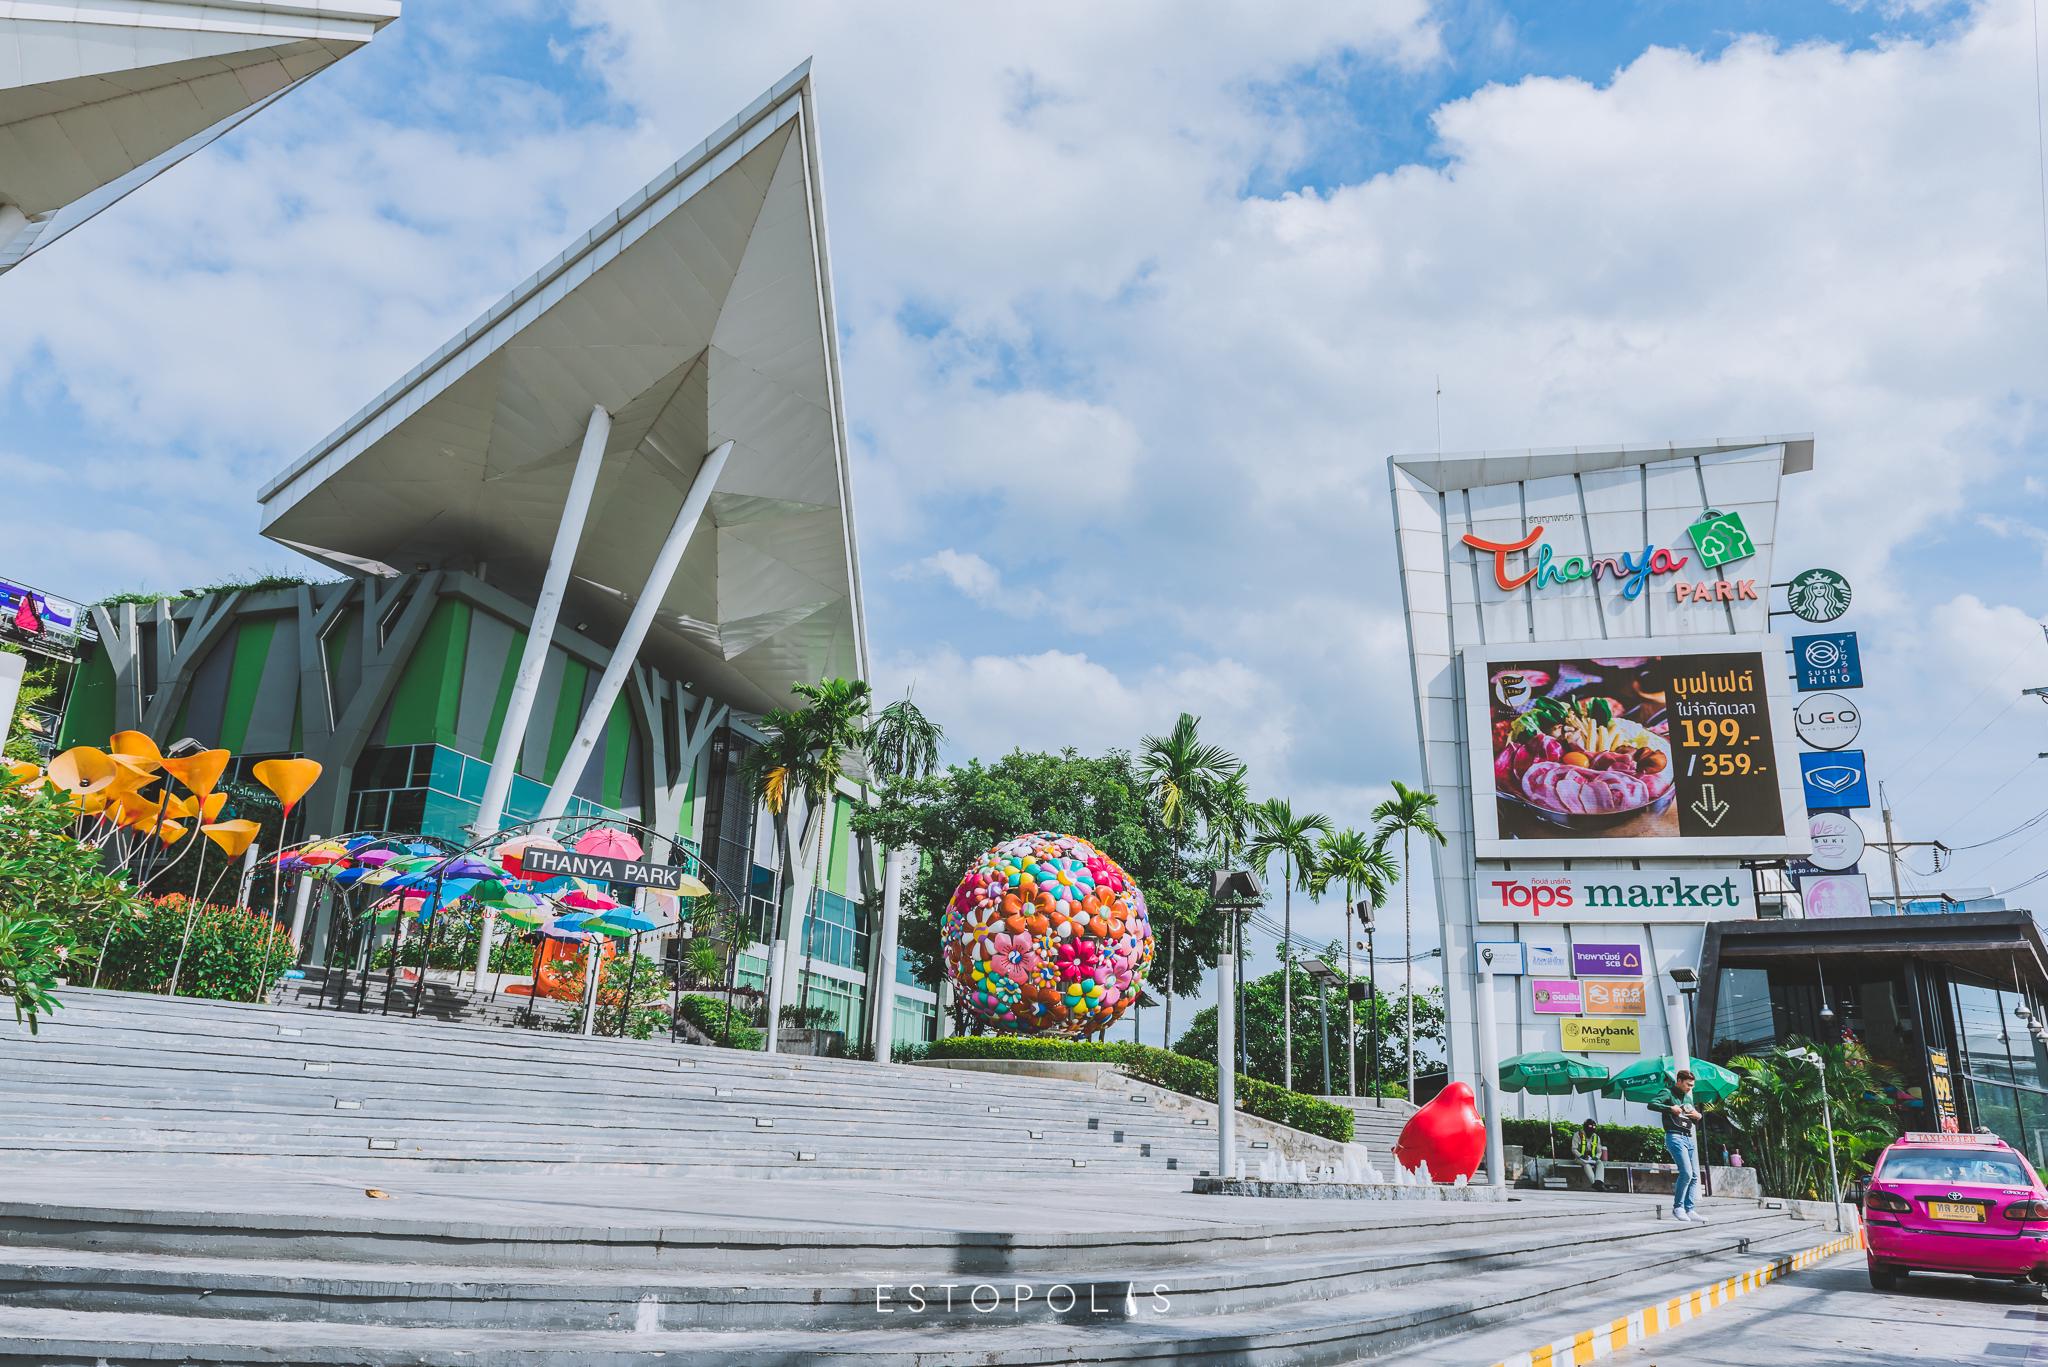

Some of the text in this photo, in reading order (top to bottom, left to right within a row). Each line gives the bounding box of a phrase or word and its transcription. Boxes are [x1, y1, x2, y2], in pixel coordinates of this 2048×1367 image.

[1462, 525, 1688, 601] Thanya
[1675, 579, 1757, 603] PARK
[1673, 670, 1753, 700] บุฟเฟต์
[1809, 674, 1850, 684] HIRO
[1798, 710, 1856, 725] UGO
[1681, 718, 1760, 747] 199.-
[530, 851, 677, 887] THANYA PARK
[1492, 876, 1739, 916] Tops market
[1581, 1026, 1634, 1036] Maybank
[1596, 1037, 1610, 1046] Eng
[1954, 1204, 1977, 1214] 2800
